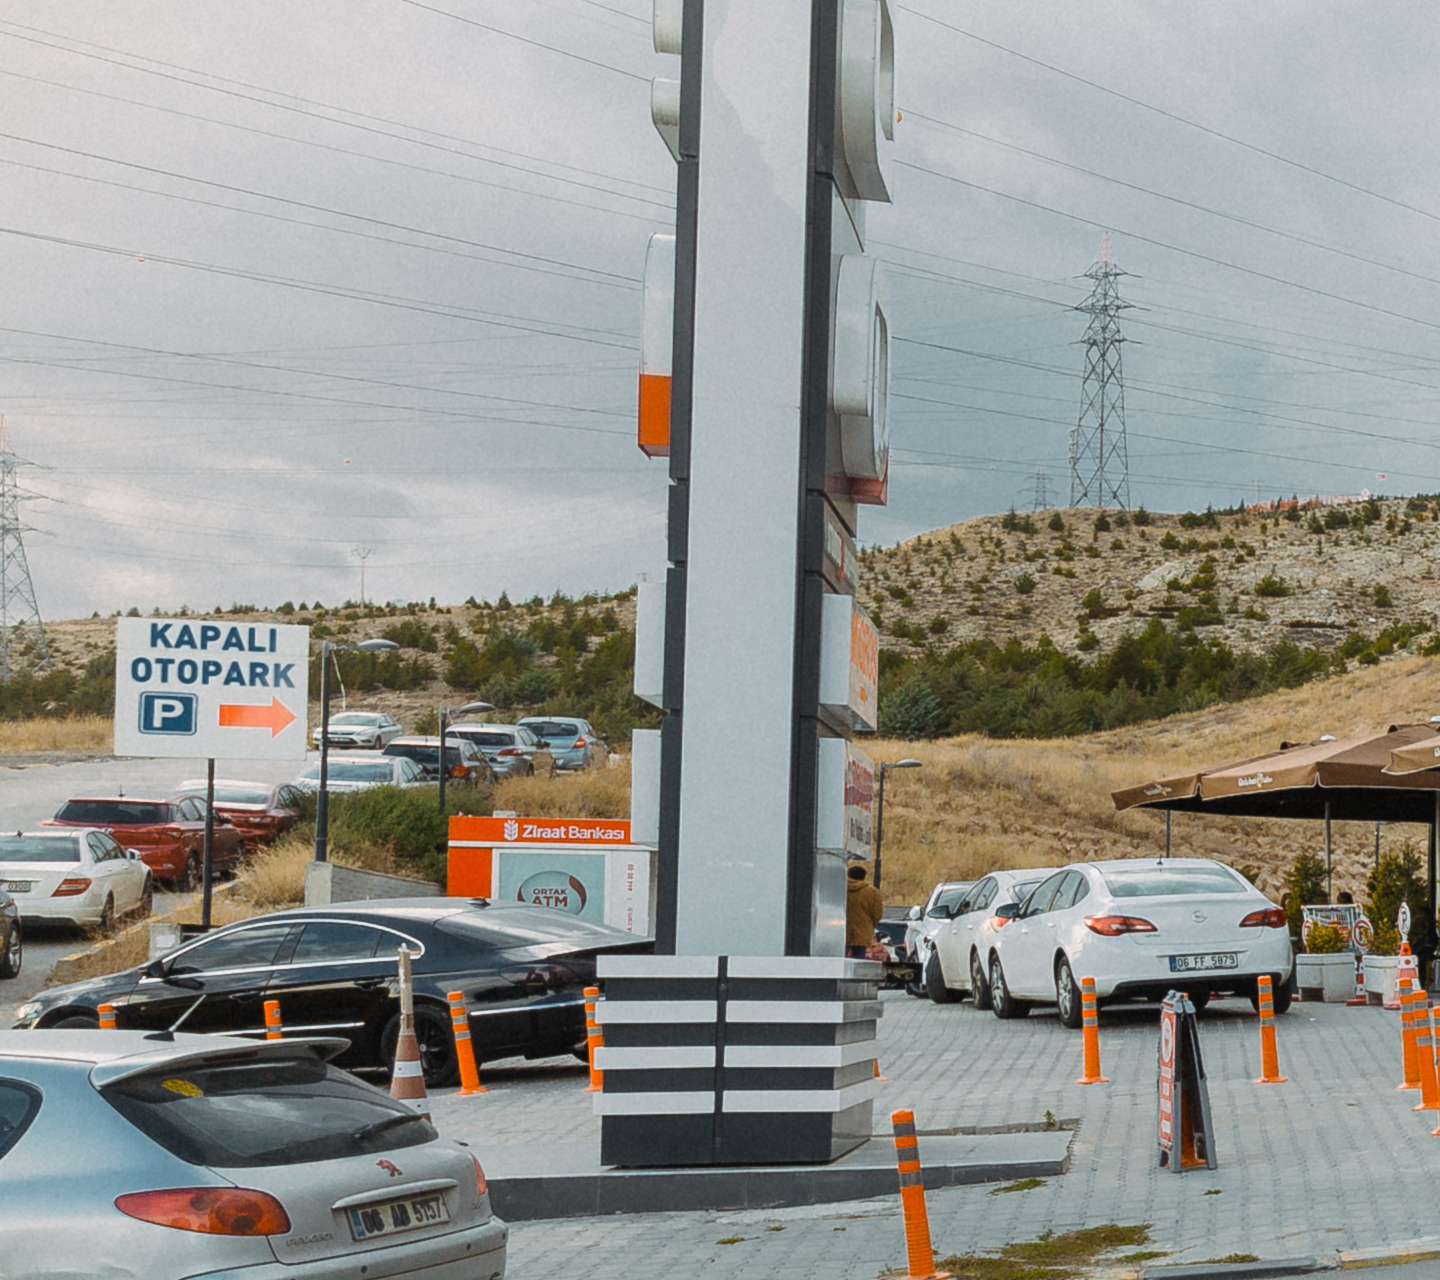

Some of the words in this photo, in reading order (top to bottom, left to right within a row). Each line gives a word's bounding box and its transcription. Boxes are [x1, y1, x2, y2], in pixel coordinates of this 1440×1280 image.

[150, 622, 277, 653] KAPALI
[131, 656, 296, 689] OTOPARK
[153, 698, 184, 728] P
[522, 824, 566, 840] Ziraat
[568, 825, 626, 840] Bankası
[532, 887, 568, 896] ORTAK
[531, 895, 569, 908] ATM
[1177, 957, 1189, 968] 06
